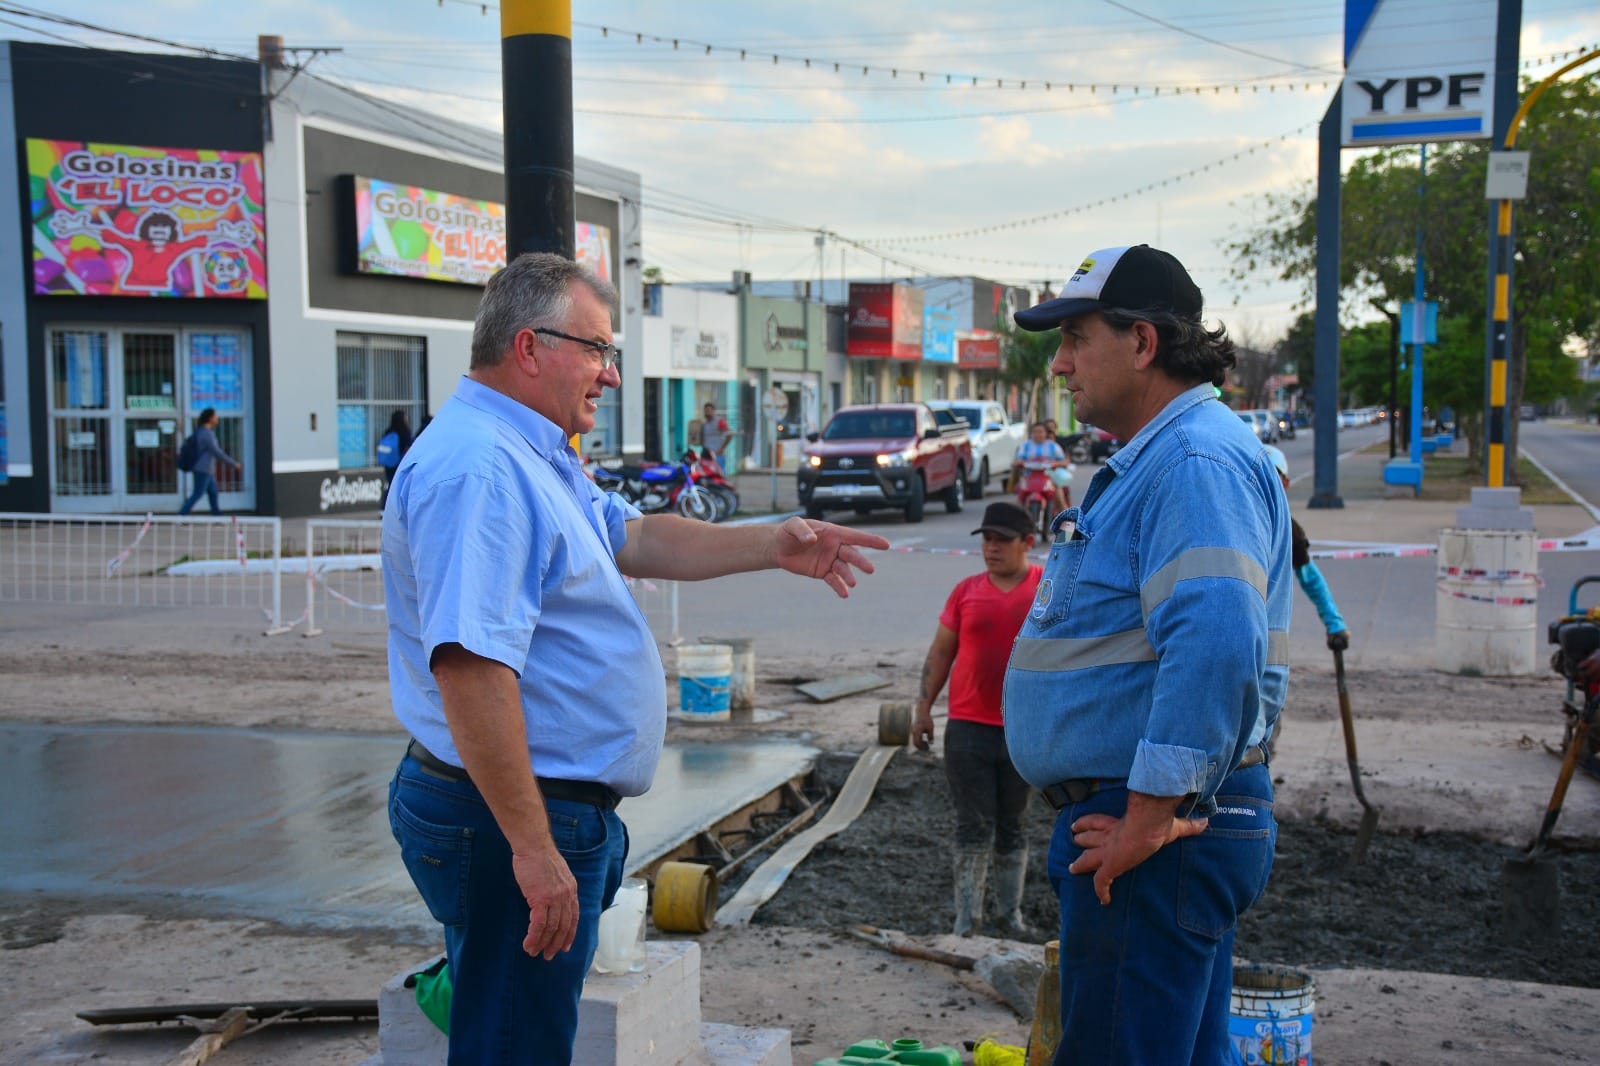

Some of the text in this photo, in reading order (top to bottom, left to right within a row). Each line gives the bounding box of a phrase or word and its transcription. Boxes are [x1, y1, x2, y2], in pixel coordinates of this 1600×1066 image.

[1356, 73, 1484, 111] YPF
[67, 154, 234, 180] Golosinas
[374, 191, 506, 233] Golosinas
[320, 475, 382, 510] Golosinas
